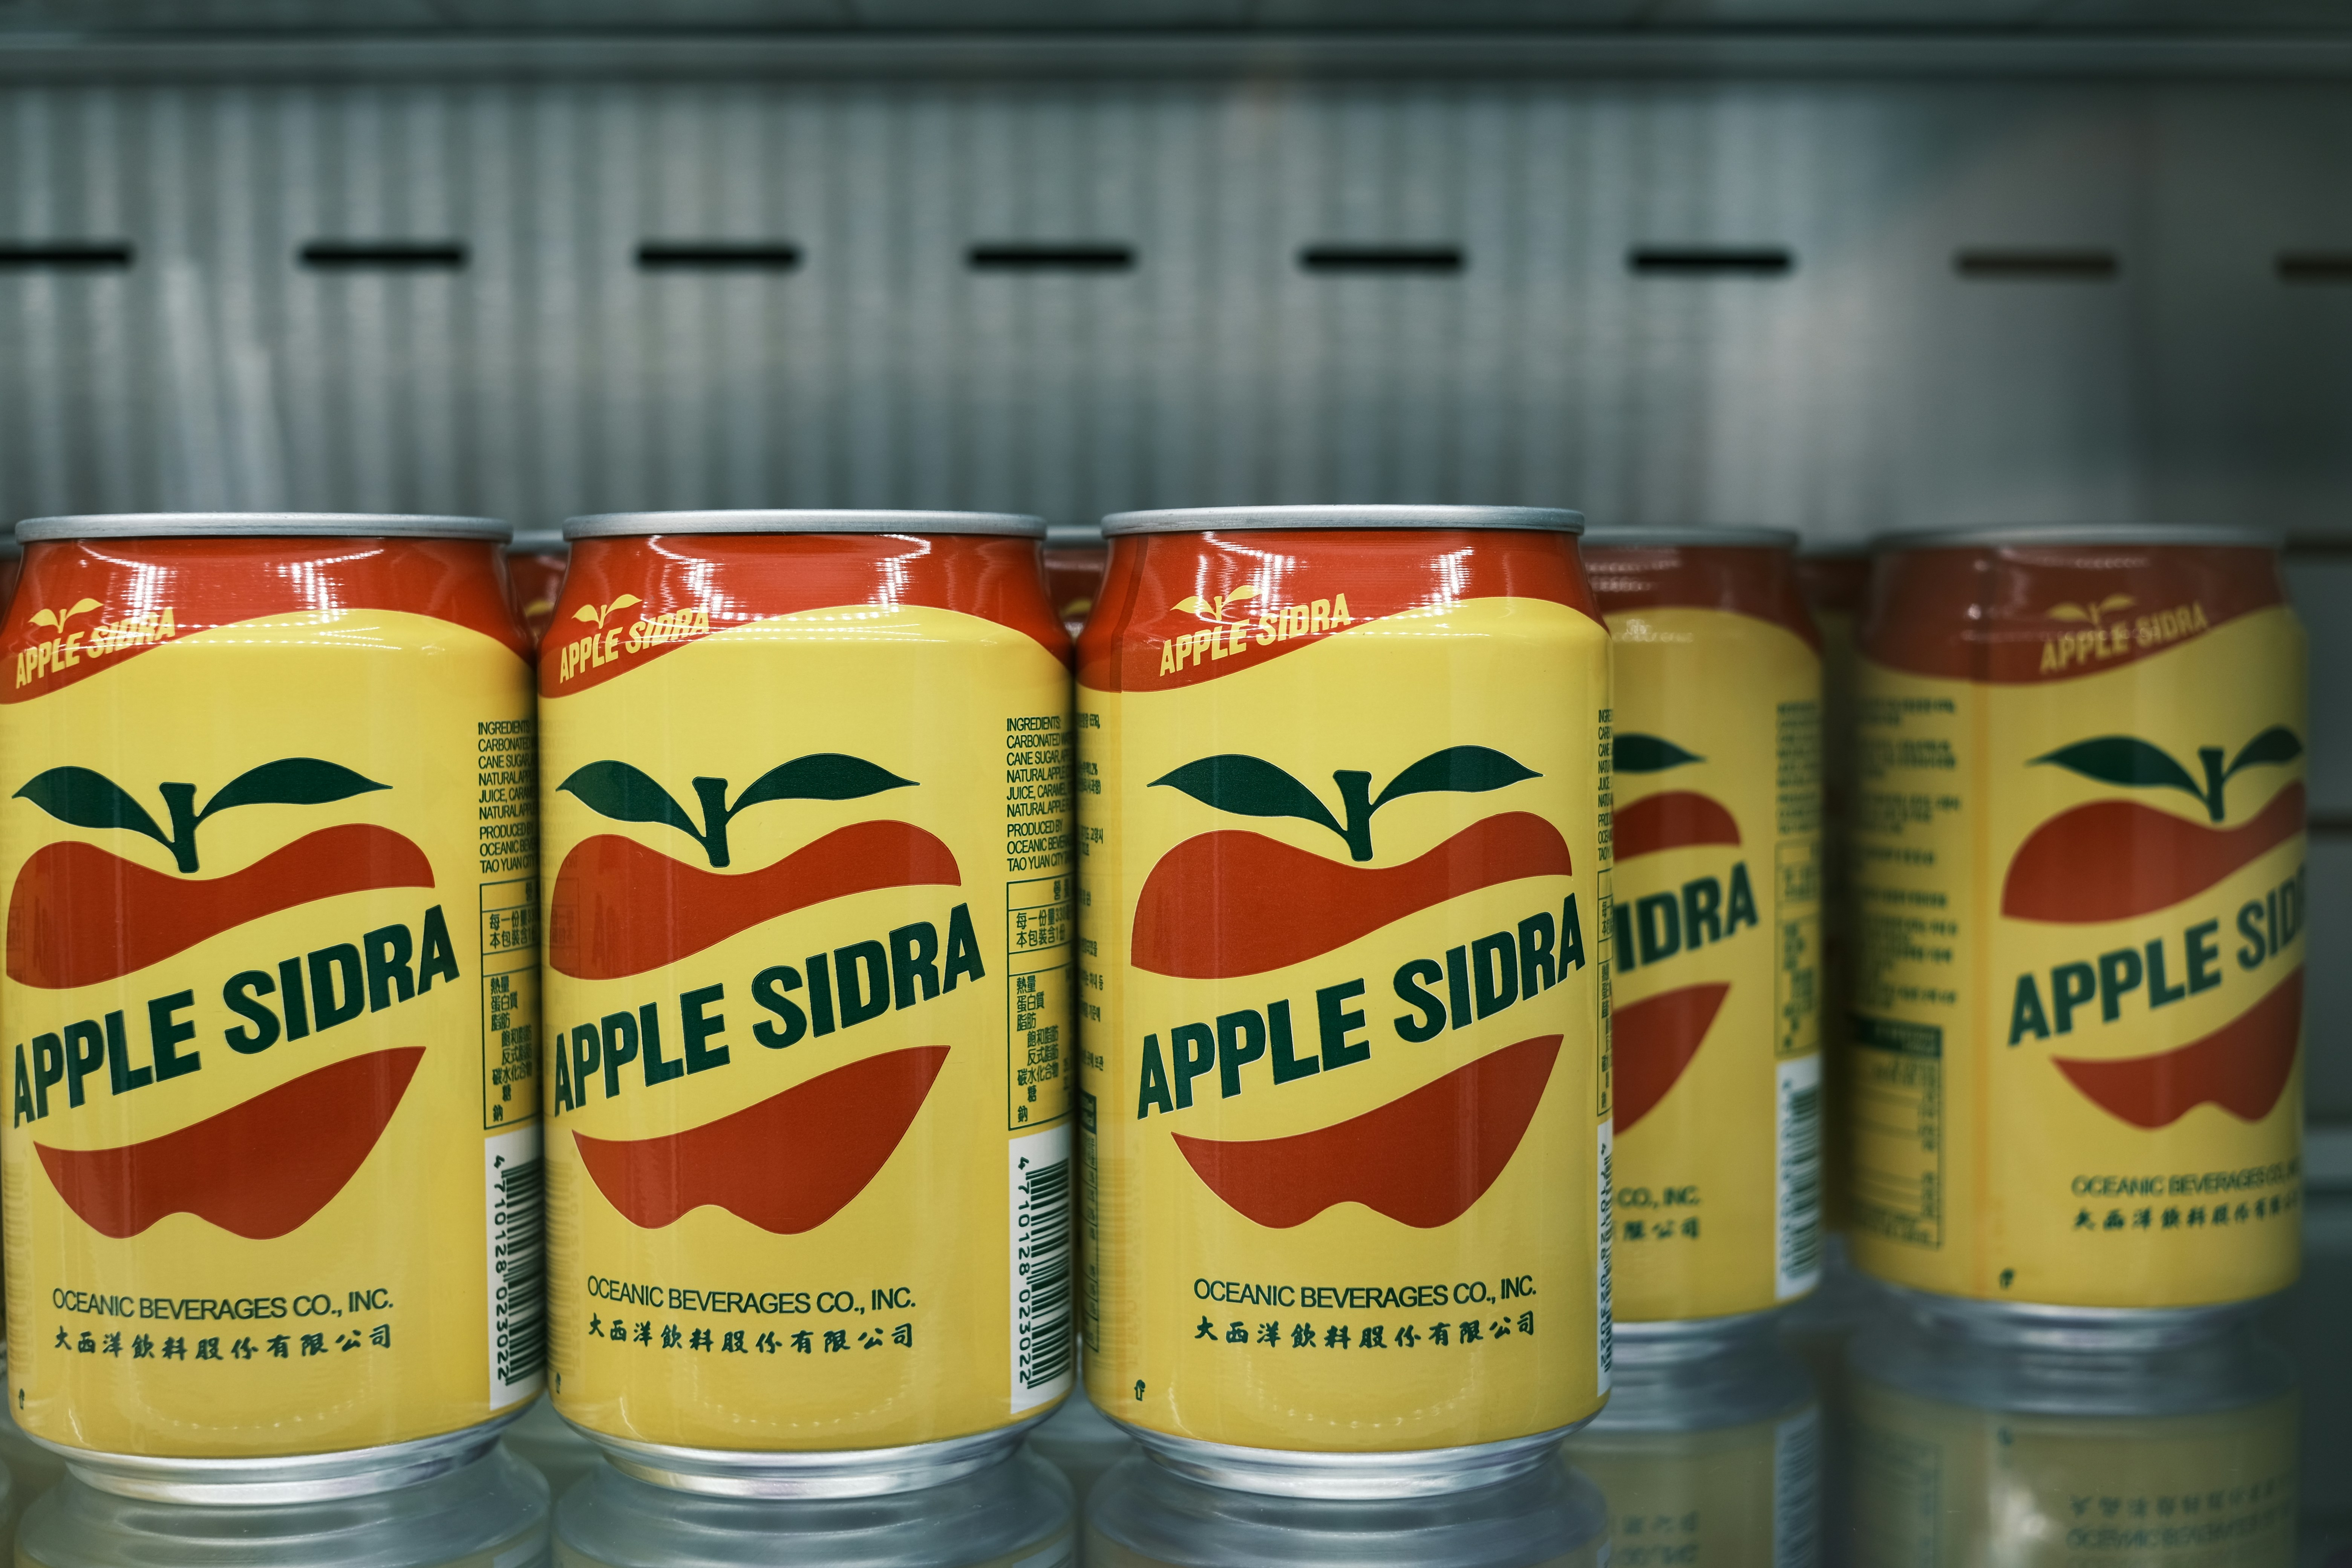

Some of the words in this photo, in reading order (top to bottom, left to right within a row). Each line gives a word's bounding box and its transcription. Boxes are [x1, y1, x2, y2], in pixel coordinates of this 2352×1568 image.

[560, 627, 623, 684] APPLE
[625, 605, 709, 654] SIDRA
[1160, 619, 1250, 677] APPLE
[1256, 593, 1351, 646] SIDRA
[2040, 620, 2129, 674] APPLE
[2135, 600, 2208, 648] SIDRA
[16, 632, 84, 689] APPLE
[87, 607, 175, 658] SIDRA
[478, 737, 530, 752] CARBONATED
[1006, 733, 1060, 749] CARBONATED
[1598, 743, 1609, 757] CANE
[478, 755, 504, 769] CANE
[1006, 751, 1033, 766] CANE
[479, 771, 519, 786] NATURAL
[1007, 768, 1047, 783] NATURAL
[1048, 766, 1066, 780] APPLE
[479, 788, 507, 803] JUICE,
[1006, 785, 1036, 801] JUICE,
[479, 804, 519, 820] NATURAL
[1007, 802, 1047, 818] NATURAL
[1048, 799, 1066, 814] APPLE
[479, 823, 526, 840] PRODUCED
[527, 821, 534, 834] BY
[1007, 820, 1054, 838] PRODUCED
[1056, 819, 1063, 832] BY
[479, 839, 519, 857] OCEANIC
[1007, 838, 1047, 854] OCEANIC
[1598, 847, 1607, 861] TAO
[479, 858, 499, 874] TAO
[501, 856, 522, 872] YUAN
[1007, 857, 1027, 872] TAO
[1028, 854, 1050, 870] YUAN
[1051, 852, 1063, 867] CITY
[1613, 860, 1759, 975] IDRA
[1017, 975, 1036, 995] 熱量
[2007, 917, 2222, 1048] APPLE
[554, 983, 730, 1118] APPLE
[751, 902, 986, 1049] SIDRA
[1017, 991, 1044, 1013] 蛋白質
[1137, 978, 1370, 1120] APPLE
[1393, 892, 1585, 1043] SIDRA
[14, 989, 201, 1129] APPLE
[223, 904, 460, 1055] SIDRA
[1017, 1012, 1036, 1032] 脂肪
[494, 1156, 505, 1168] 4
[1018, 1156, 1030, 1170] 4
[2071, 1174, 2166, 1198] OCEANIC
[2168, 1166, 2265, 1197] BEVERAGES
[494, 1179, 506, 1274] 710128
[1018, 1181, 1031, 1277] 710128
[588, 1275, 664, 1307] OCEANIC
[669, 1288, 811, 1314] BEVERAGES
[817, 1291, 865, 1315] CO.,
[872, 1286, 916, 1310] INC.
[1194, 1278, 1295, 1307] OCEANIC
[1301, 1284, 1448, 1308] BEVERAGES
[1453, 1281, 1496, 1304] CO.,
[1501, 1275, 1536, 1300] INC.
[54, 1288, 135, 1317] OCEANIC
[140, 1297, 287, 1320] BEVERAGES
[293, 1294, 342, 1317] CO.,
[349, 1288, 394, 1312] INC.
[496, 1286, 510, 1381] 023022
[588, 1312, 912, 1354] 大西洋飲料股份有限公司
[1018, 1289, 1031, 1382] 023022
[1194, 1310, 1534, 1349] 大西洋飲料股份有限公司
[55, 1323, 390, 1360] 大西洋飲料股份有限公司
